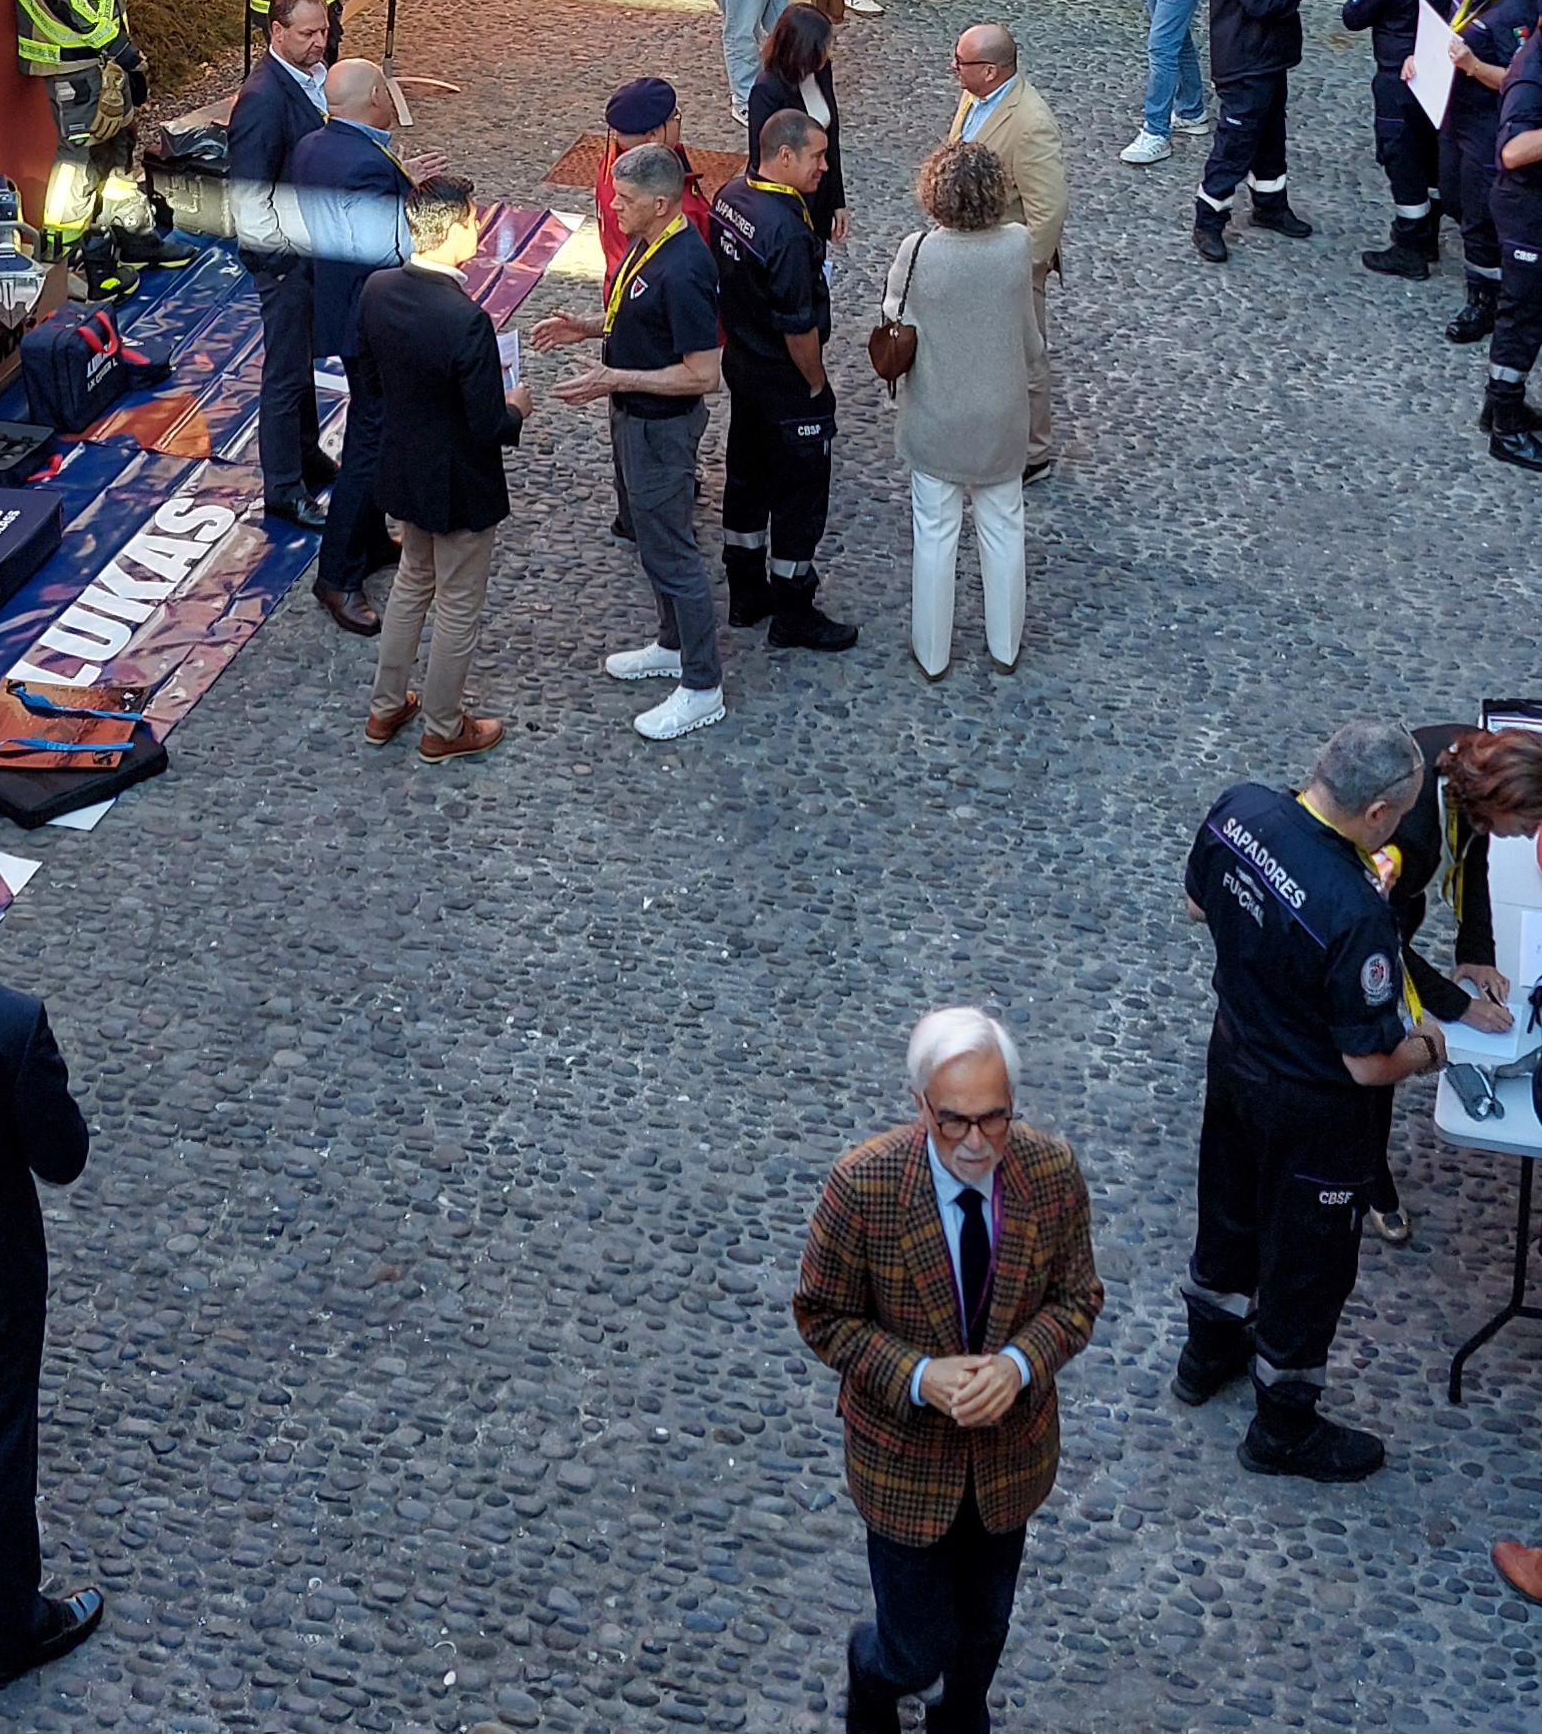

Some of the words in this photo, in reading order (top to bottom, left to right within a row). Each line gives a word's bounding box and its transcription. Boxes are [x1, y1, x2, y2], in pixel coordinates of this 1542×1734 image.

[5, 498, 235, 687] LUKAS
[1223, 817, 1306, 909] SAPADORES
[1319, 1191, 1354, 1205] CBSF
